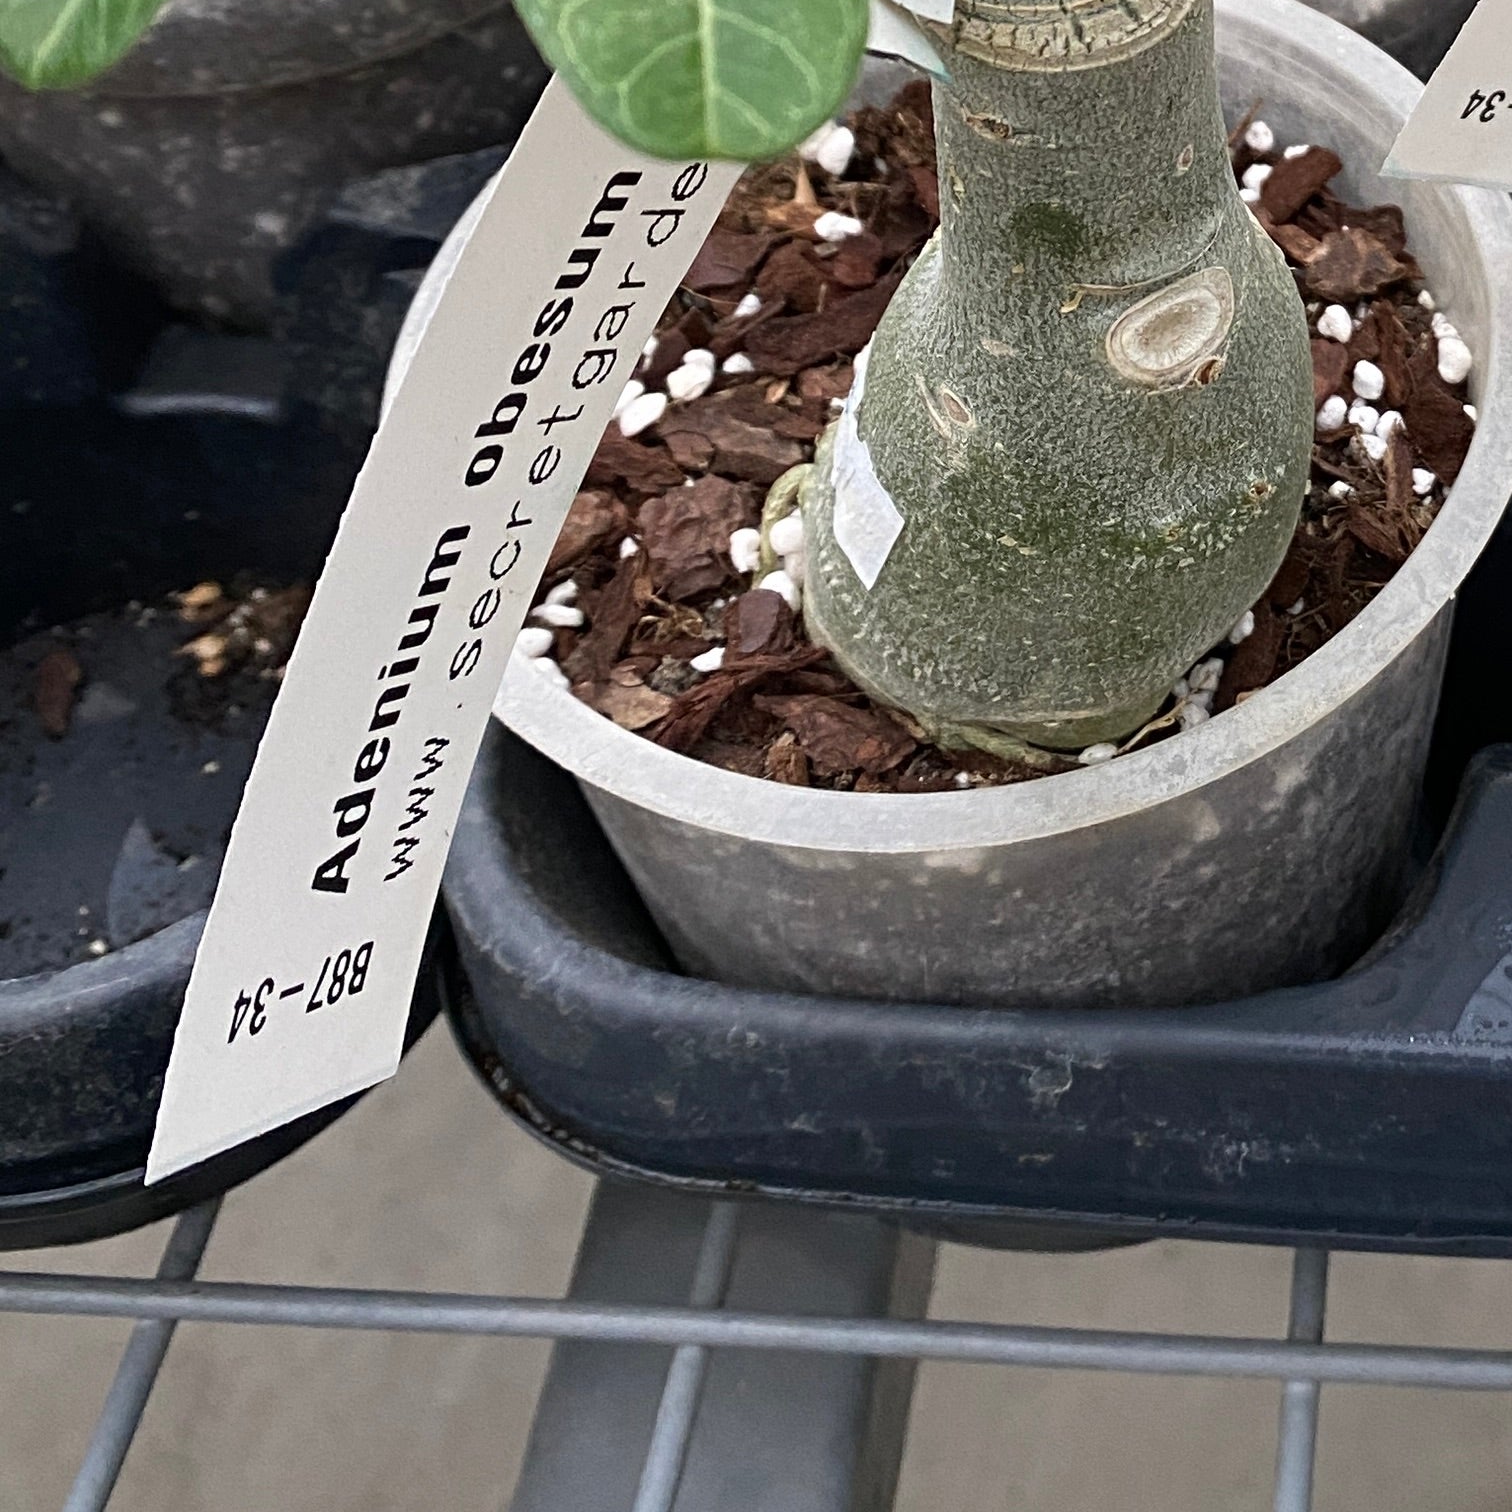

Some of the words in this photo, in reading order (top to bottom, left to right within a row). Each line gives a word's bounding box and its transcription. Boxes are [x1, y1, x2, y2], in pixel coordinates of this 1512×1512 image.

[312, 526, 470, 894] Adenium
[465, 171, 643, 488] obesum
[228, 941, 374, 1044] B87-34
